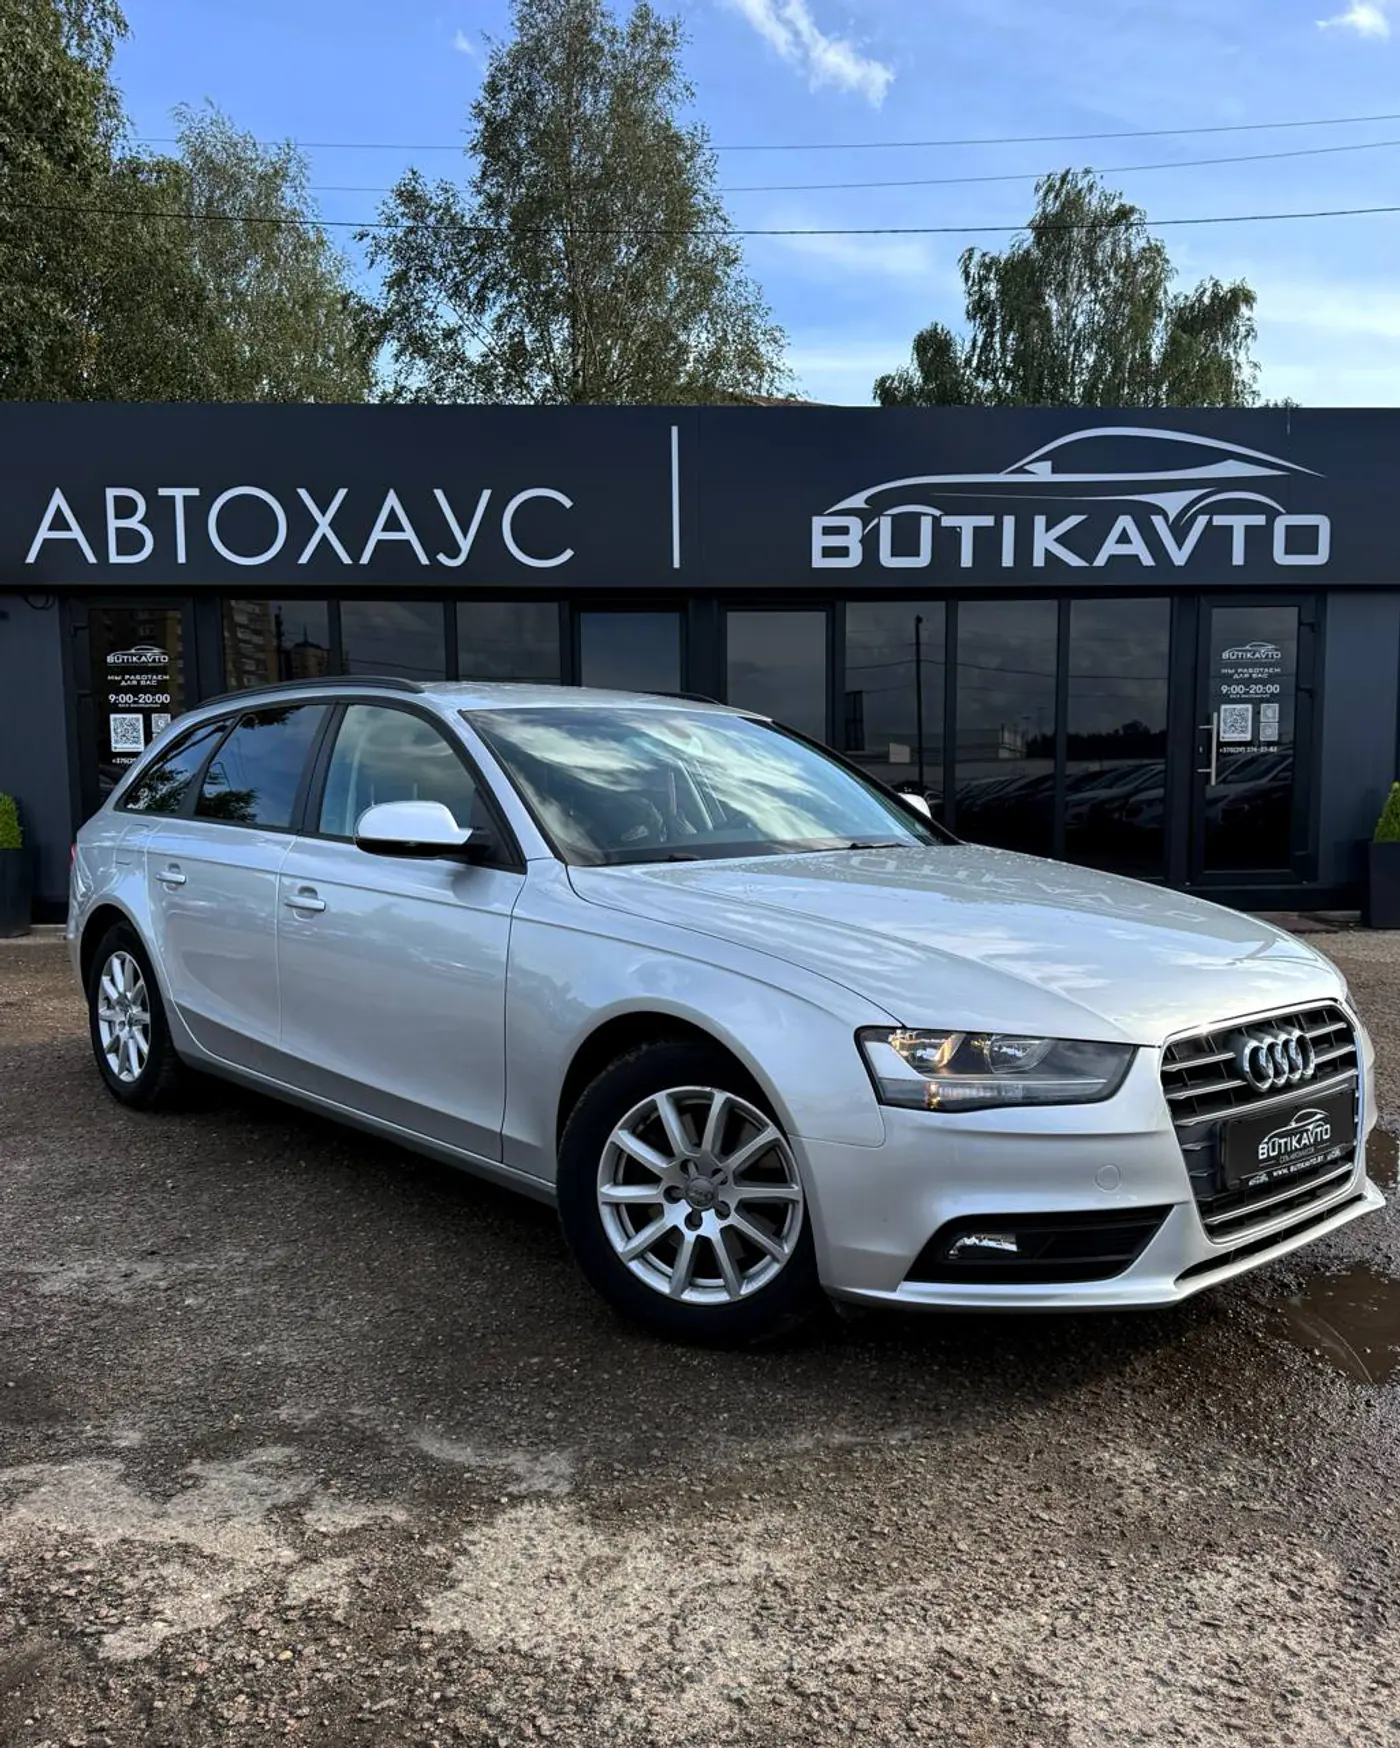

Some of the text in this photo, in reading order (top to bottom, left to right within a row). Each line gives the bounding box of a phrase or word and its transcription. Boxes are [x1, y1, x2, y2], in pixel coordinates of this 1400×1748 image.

[25, 486, 574, 568] АВТОХАУС
[811, 514, 1331, 568] BUTIKAVTO
[106, 655, 169, 663] BUTIKAVTO
[1222, 651, 1281, 660] BUTIKAVTO
[1221, 684, 1280, 694] 9:00-20:00
[108, 693, 171, 704] 9:00-20:00
[1258, 1124, 1331, 1160] BUTIKAVTO
